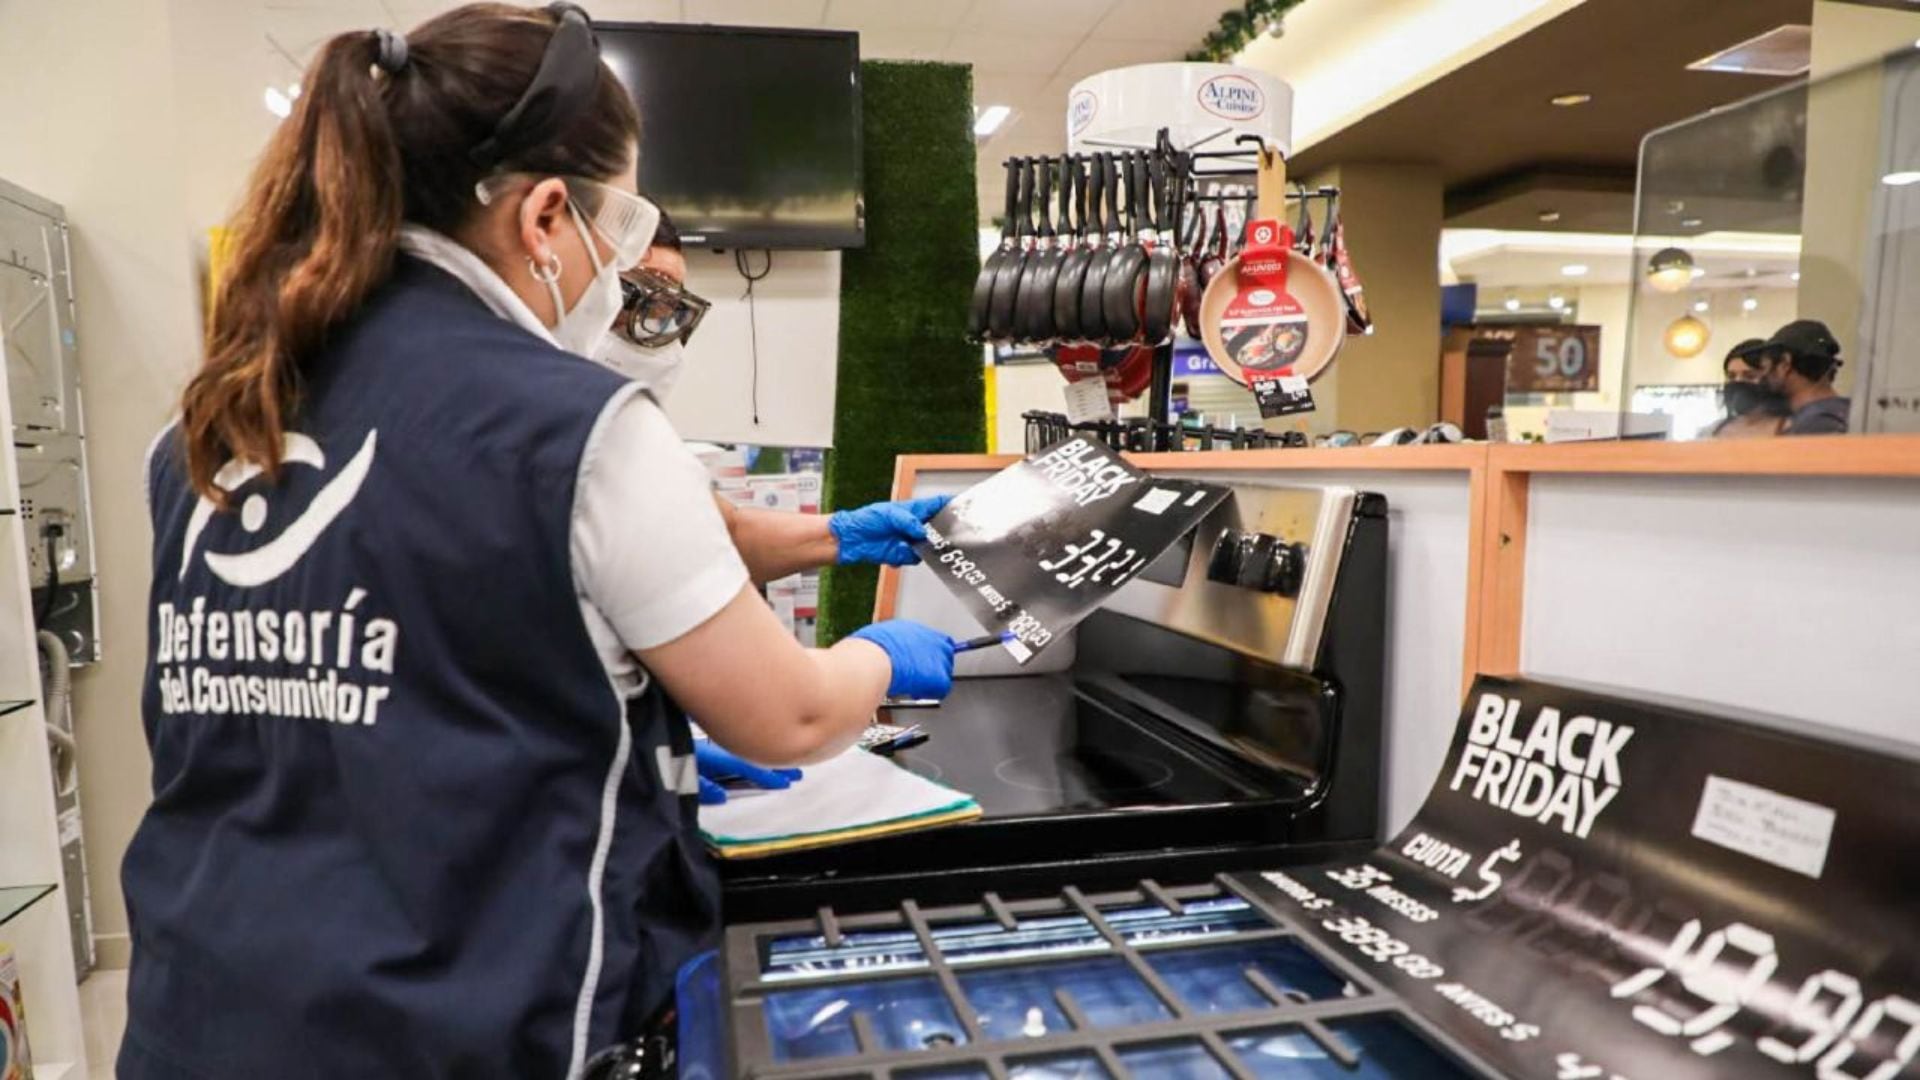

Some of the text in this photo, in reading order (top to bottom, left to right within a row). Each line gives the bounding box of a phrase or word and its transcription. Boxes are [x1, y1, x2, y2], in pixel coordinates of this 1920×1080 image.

[1205, 82, 1257, 103] ALPINE
[1216, 99, 1257, 113] Cuisine
[1187, 355, 1218, 371] Gra
[1535, 337, 1585, 378] 50
[1031, 451, 1113, 507] FRIDAY
[1056, 438, 1137, 495] BLACK
[157, 587, 398, 674] Defensoría
[159, 665, 390, 726] del Consumidor
[1468, 692, 1635, 786] BLACK
[1449, 742, 1619, 839] FRIDAY
[1402, 832, 1472, 879] CUOTA
[1451, 838, 1522, 902] $
[1365, 885, 1440, 923] MESES
